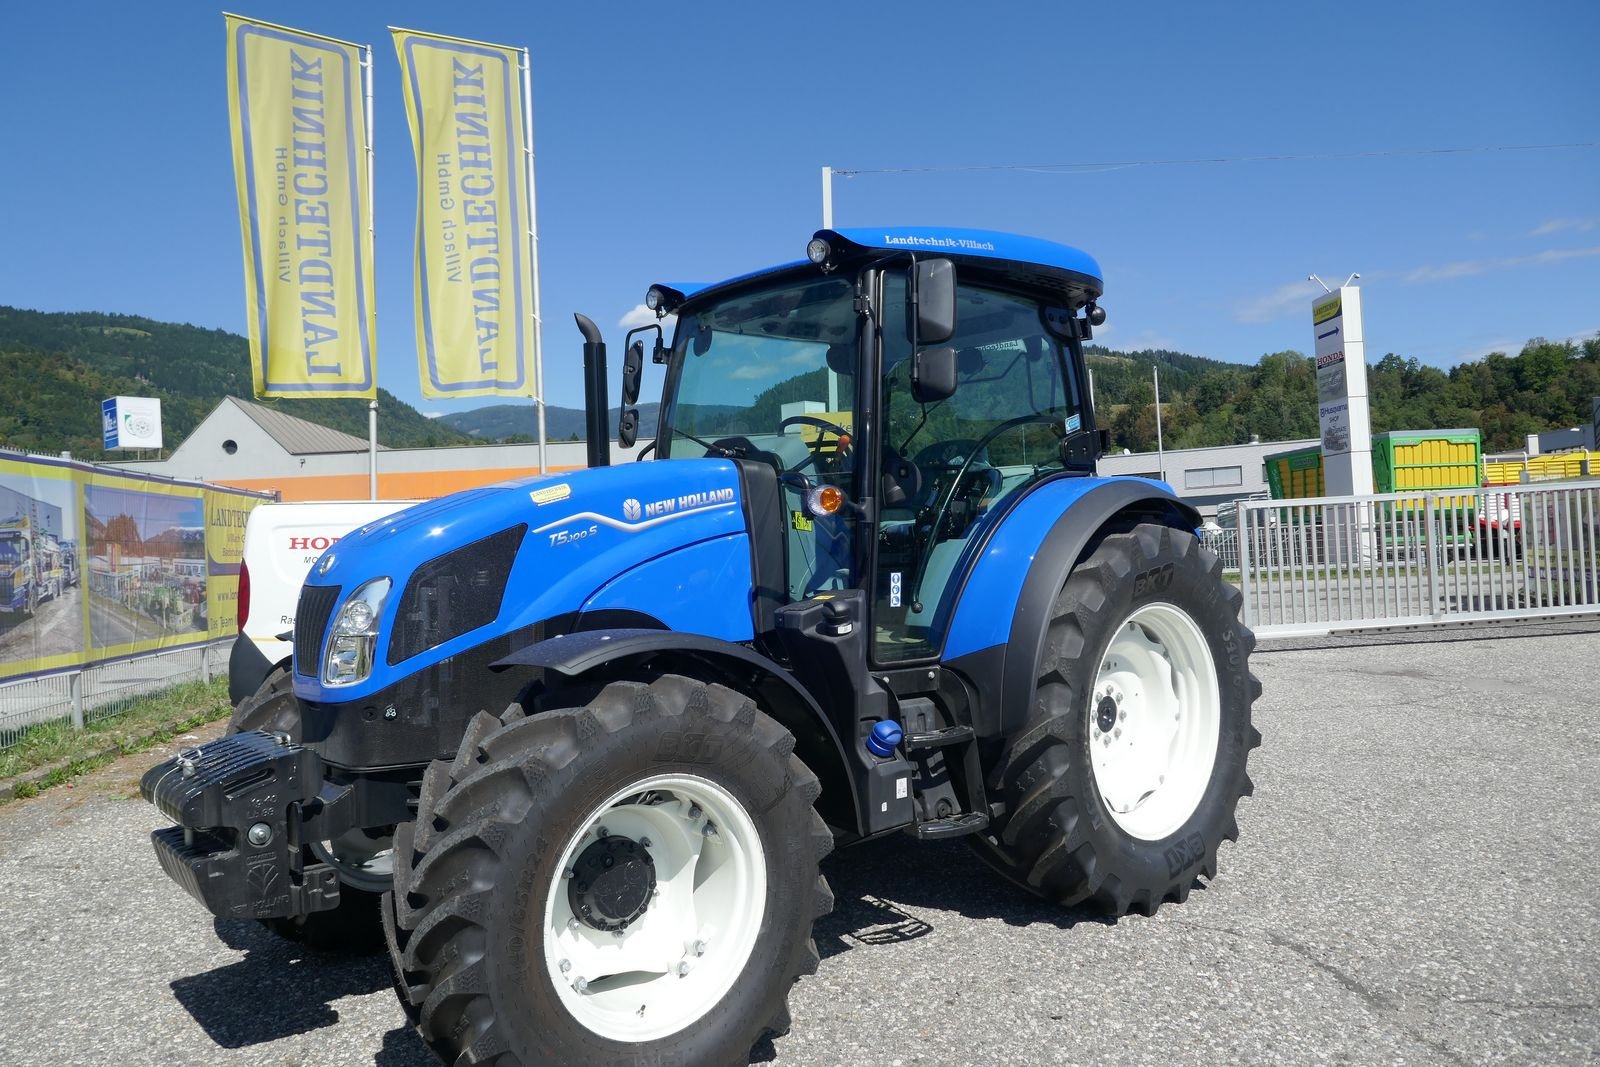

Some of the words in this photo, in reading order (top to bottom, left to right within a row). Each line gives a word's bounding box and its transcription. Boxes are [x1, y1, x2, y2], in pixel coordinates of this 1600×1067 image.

[885, 235, 995, 251] Landtechnik-Villach
[1317, 351, 1344, 366] HONDA
[645, 498, 676, 517] NEW
[678, 487, 734, 509] HOLLAND
[589, 525, 598, 536] S
[1133, 562, 1175, 597] BKT
